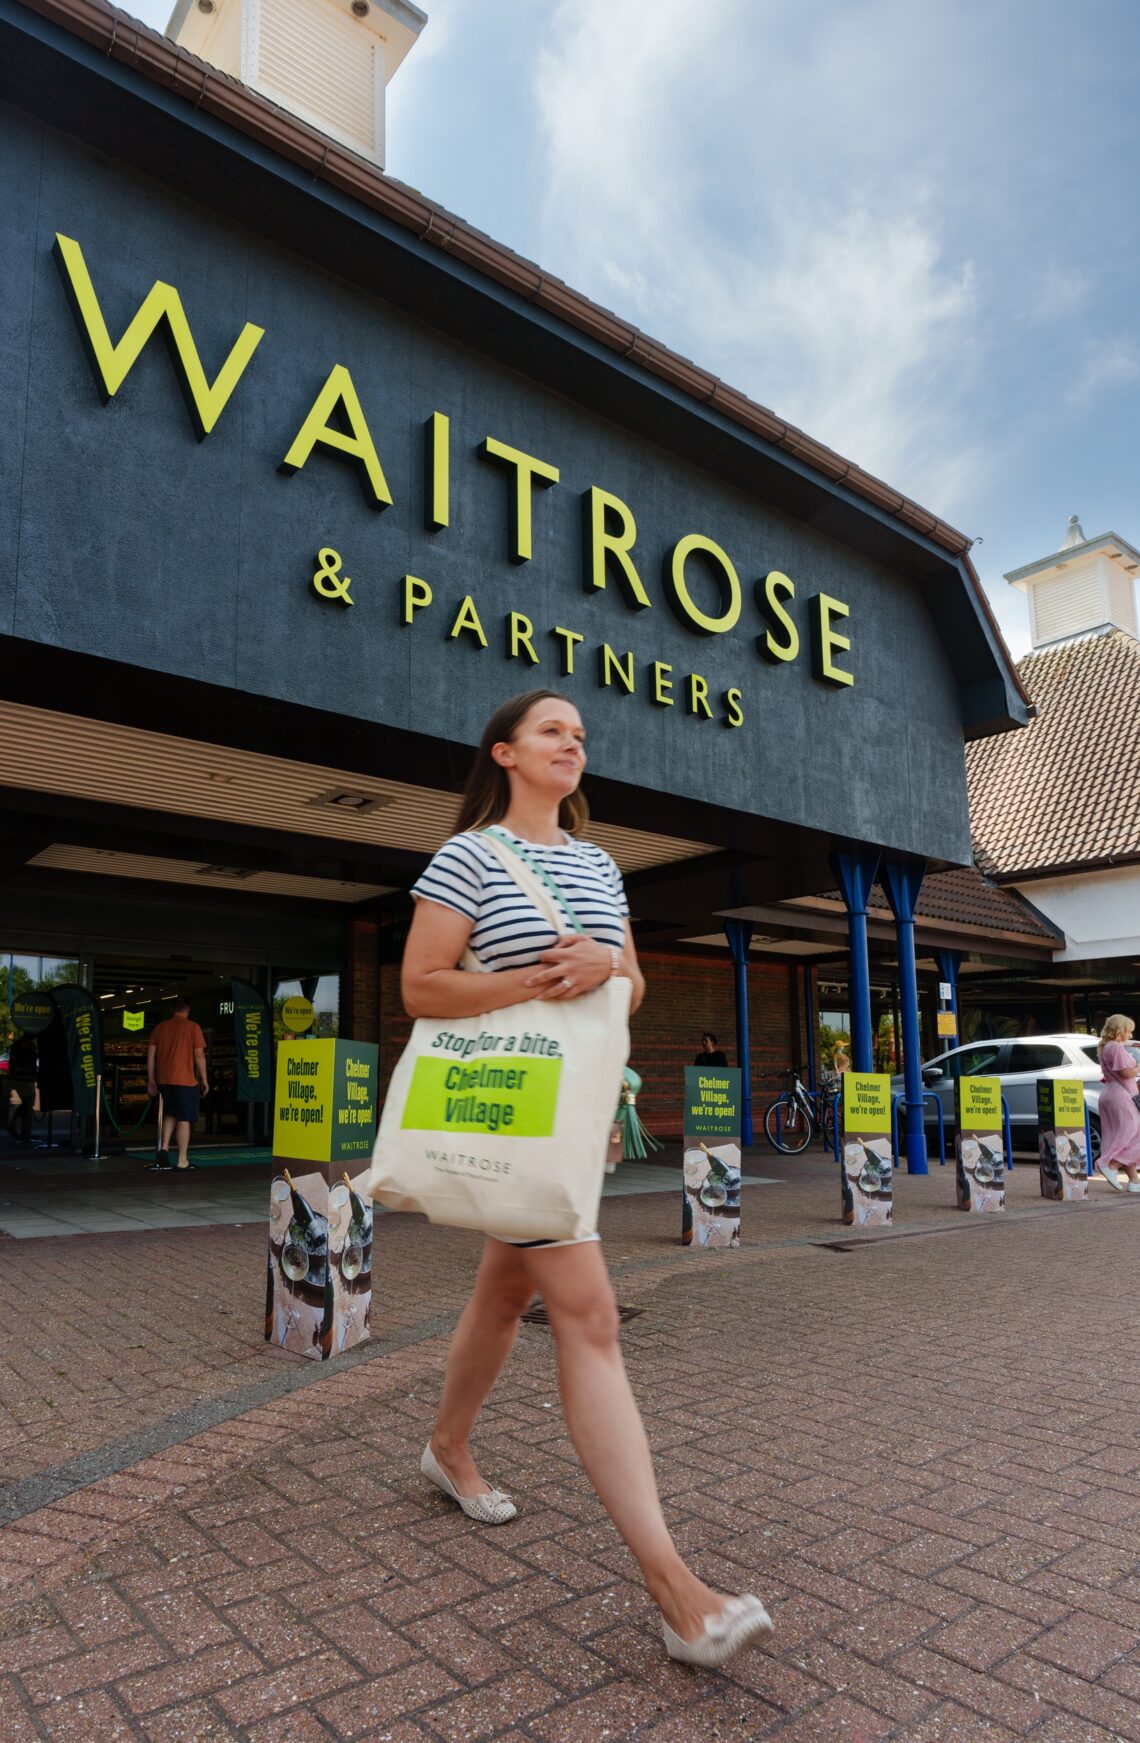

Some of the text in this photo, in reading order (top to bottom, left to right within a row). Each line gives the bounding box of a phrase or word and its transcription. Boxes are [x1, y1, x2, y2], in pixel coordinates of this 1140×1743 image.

[54, 231, 855, 686] WAITROSE
[312, 547, 745, 729] & PARTNERS
[76, 1013, 93, 1053] We're
[244, 1012, 262, 1078] We're open
[431, 1032, 476, 1058] Stop
[504, 1036, 517, 1052] a
[518, 1032, 564, 1058] bite.
[81, 1055, 97, 1088] open
[287, 1057, 319, 1076] Chelmer
[345, 1058, 370, 1079] Chelmer
[444, 1064, 528, 1092] Chelmer
[288, 1081, 317, 1103] Village,
[347, 1082, 369, 1105] Village,
[698, 1076, 730, 1089] Chelmer
[855, 1081, 881, 1092] Chelmer
[969, 1084, 993, 1094] Chelmer
[701, 1090, 729, 1105] Village,
[857, 1093, 881, 1105] Village,
[280, 1103, 323, 1126] we're open!
[338, 1104, 373, 1127] we're open!
[444, 1096, 515, 1131] Village
[691, 1104, 735, 1119] we're open!
[850, 1104, 886, 1116] we're open!
[340, 1140, 369, 1151] WAITROSE
[424, 1149, 513, 1175] WAITROSE
